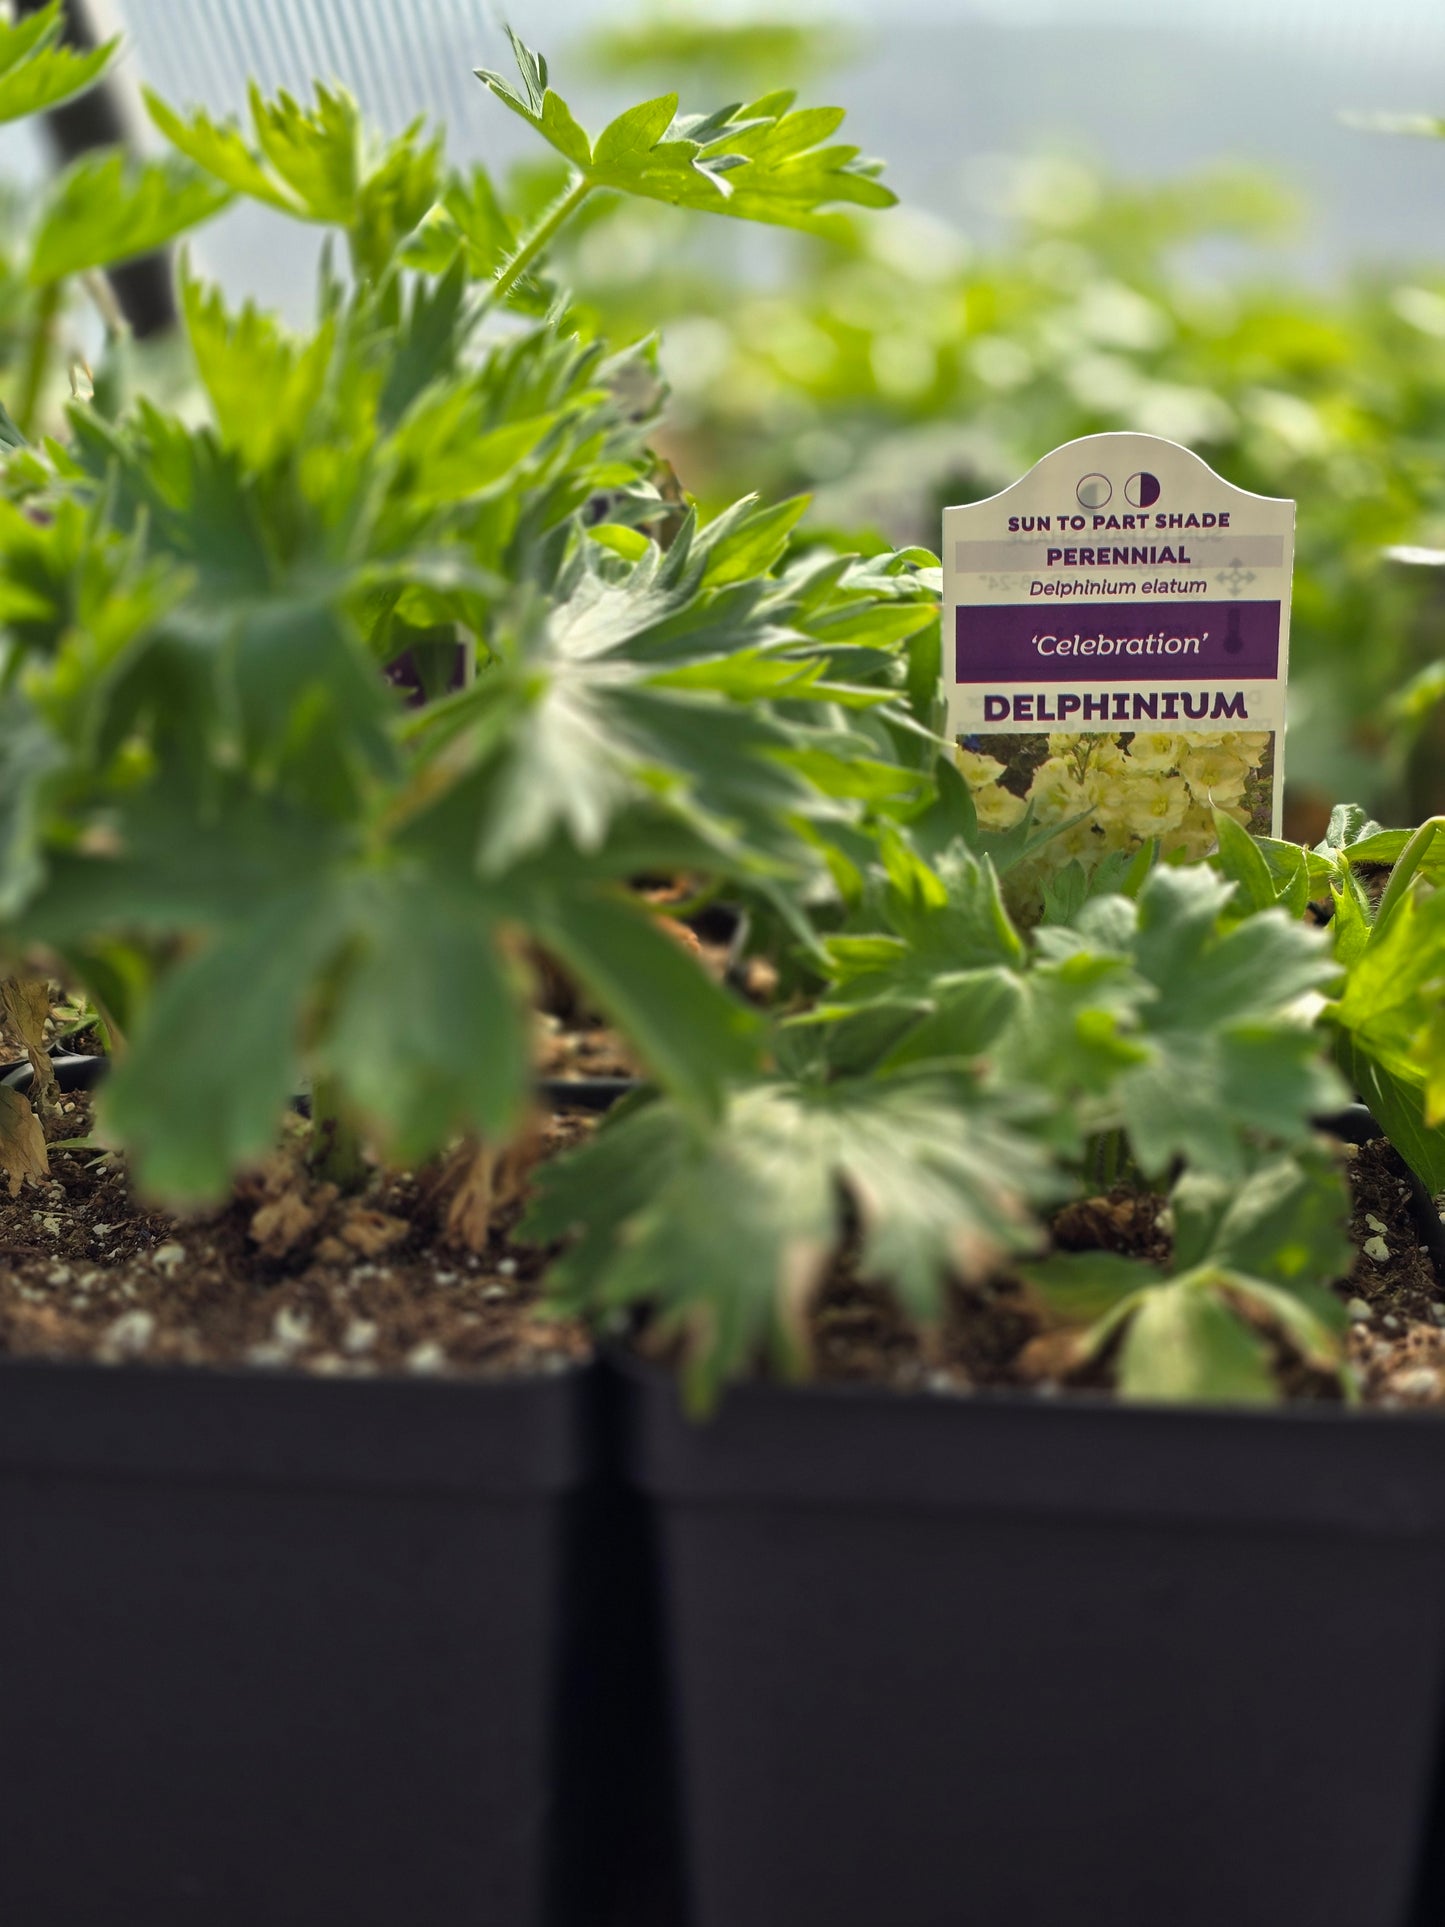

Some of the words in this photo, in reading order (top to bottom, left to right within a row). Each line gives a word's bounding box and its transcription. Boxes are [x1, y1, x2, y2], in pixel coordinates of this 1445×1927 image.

[1008, 516, 1051, 533] SUN
[1056, 515, 1086, 531] TO
[1092, 513, 1150, 531] PART
[1154, 512, 1231, 529] SHADE
[1046, 545, 1191, 567] PERENNIAL
[1029, 578, 1137, 598] Delphinium
[1141, 577, 1207, 594] elatum
[983, 691, 1249, 722] DELPHINIUM
